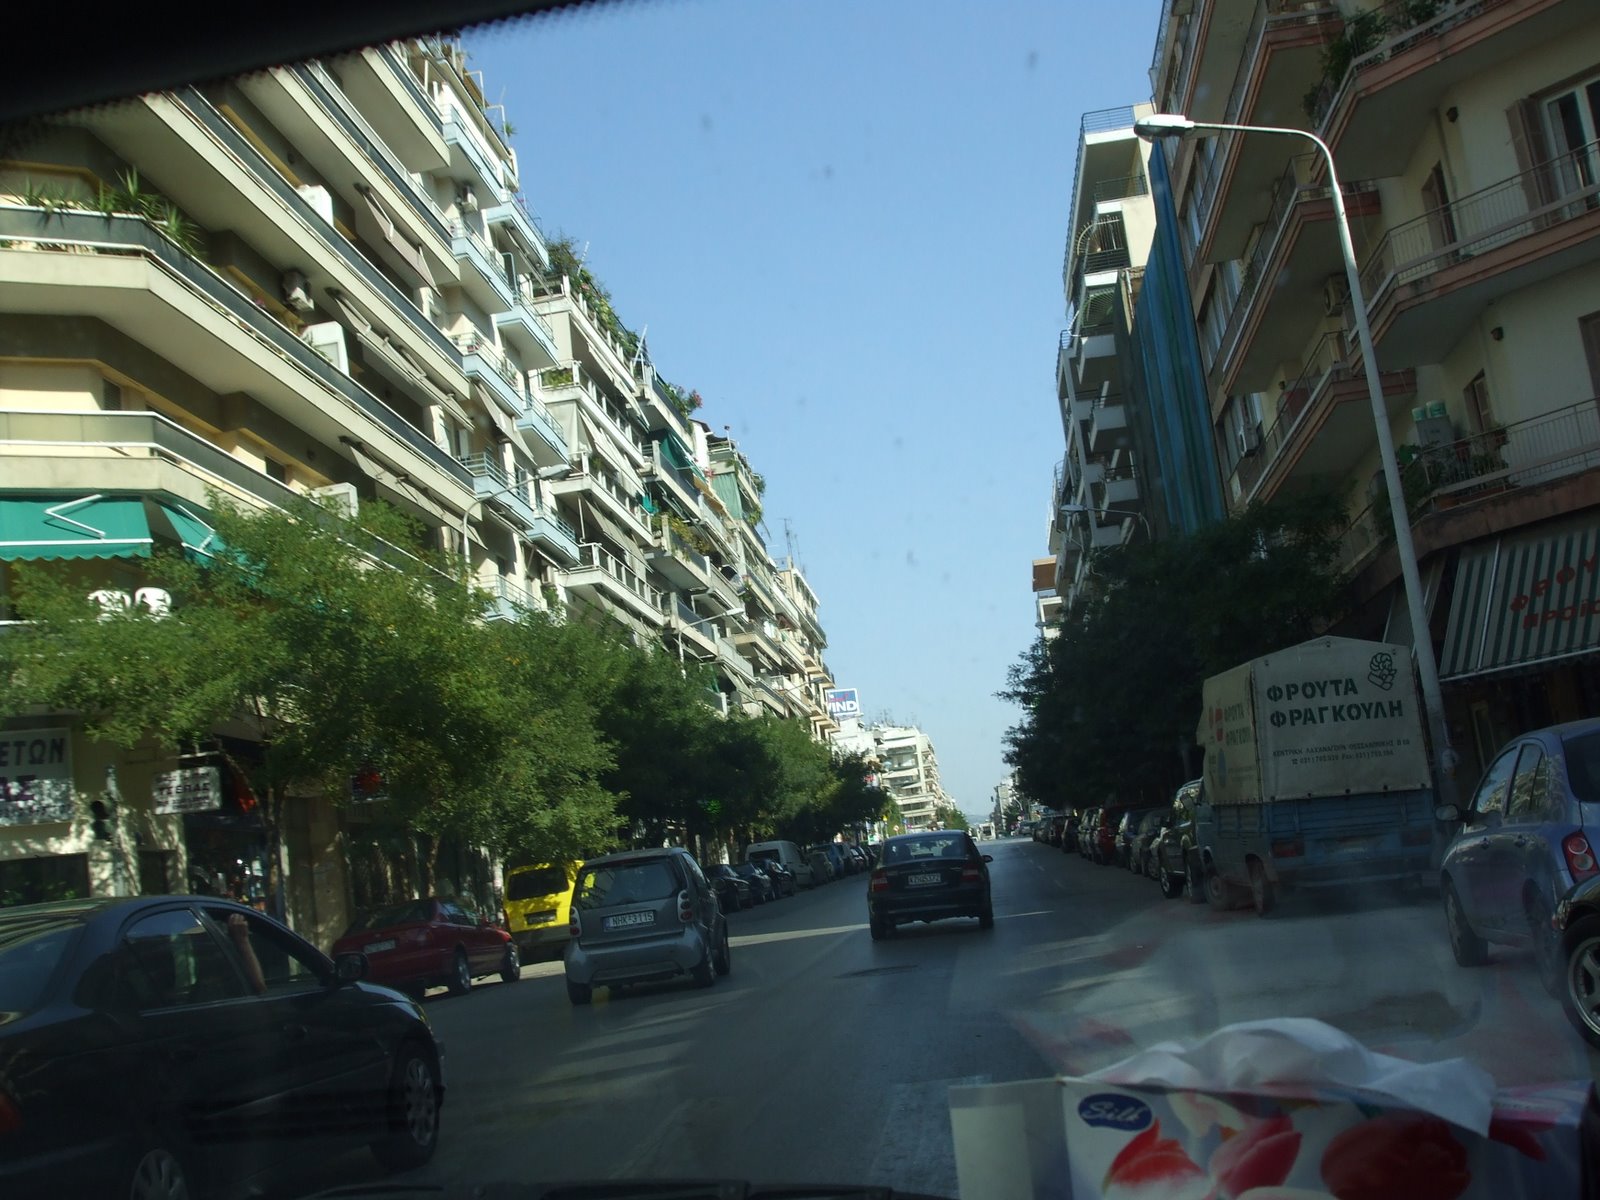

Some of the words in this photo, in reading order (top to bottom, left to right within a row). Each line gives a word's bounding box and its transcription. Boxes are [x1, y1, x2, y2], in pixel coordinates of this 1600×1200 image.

[1266, 678, 1359, 703] ΦΡΟΥΤΑ
[1269, 700, 1403, 728] ΦΡΑΓΚΟΥΛΗ
[1081, 1101, 1149, 1121] Silk
